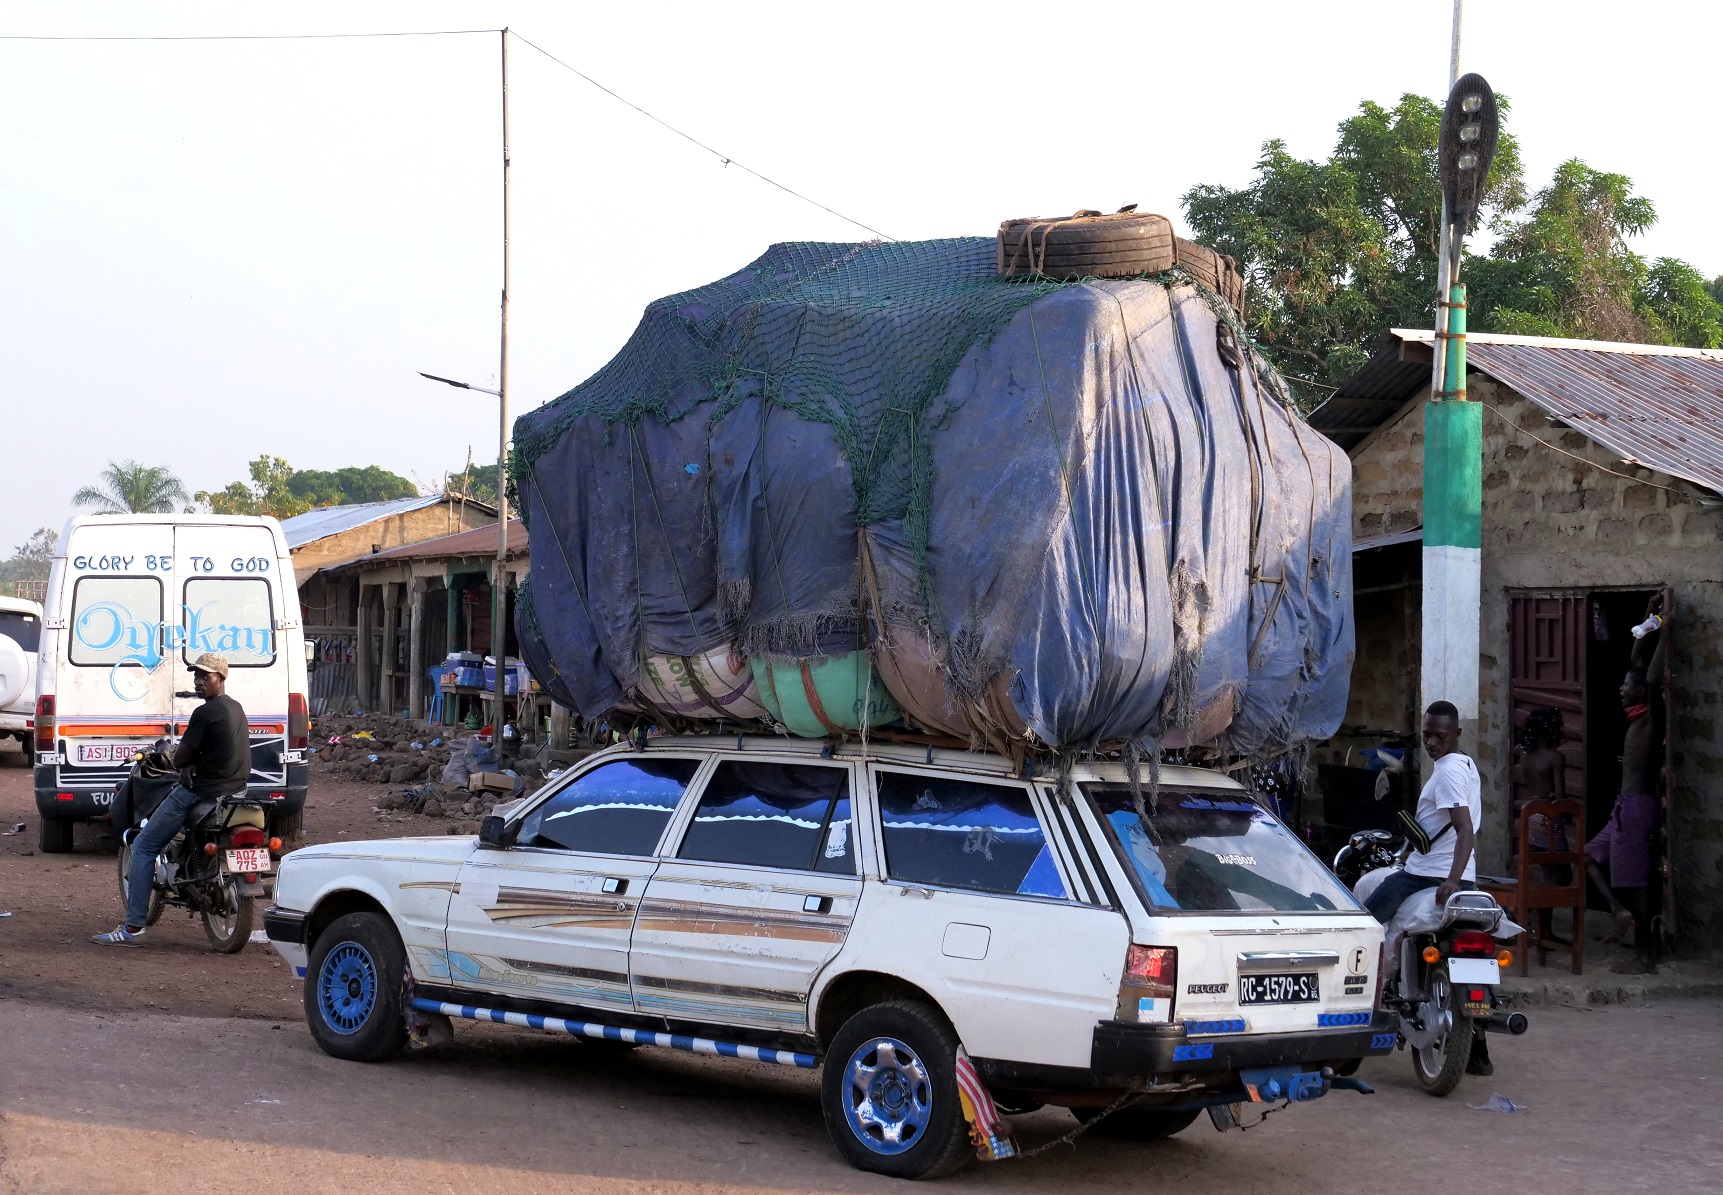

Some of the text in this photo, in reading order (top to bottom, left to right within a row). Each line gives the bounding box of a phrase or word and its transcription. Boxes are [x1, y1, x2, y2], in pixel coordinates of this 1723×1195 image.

[73, 555, 270, 573] GLORY BE TO GOD
[236, 850, 257, 861] AQZ
[236, 860, 258, 871] 775
[1354, 949, 1363, 972] F
[1188, 983, 1230, 994] PEUGEOT
[1240, 976, 1309, 1002] RC-1579-S
